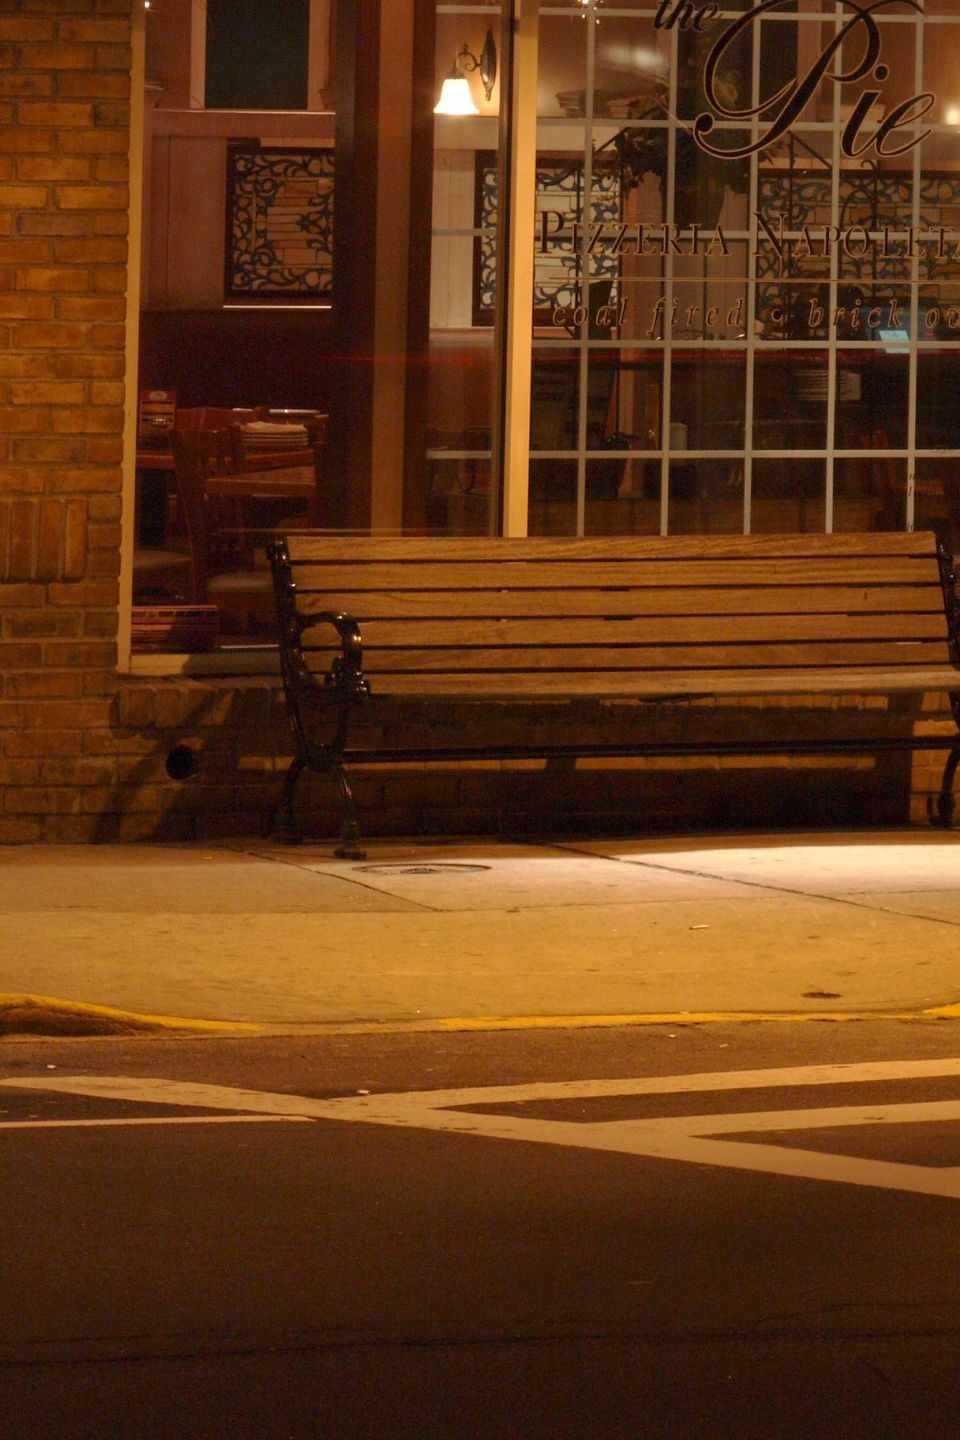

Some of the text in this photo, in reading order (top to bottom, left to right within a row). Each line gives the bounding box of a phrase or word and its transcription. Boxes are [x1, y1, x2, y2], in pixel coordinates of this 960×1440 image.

[536, 210, 732, 256] PIZZERIA
[552, 297, 629, 326] coal
[646, 297, 744, 336] fired
[808, 298, 905, 328] brick
